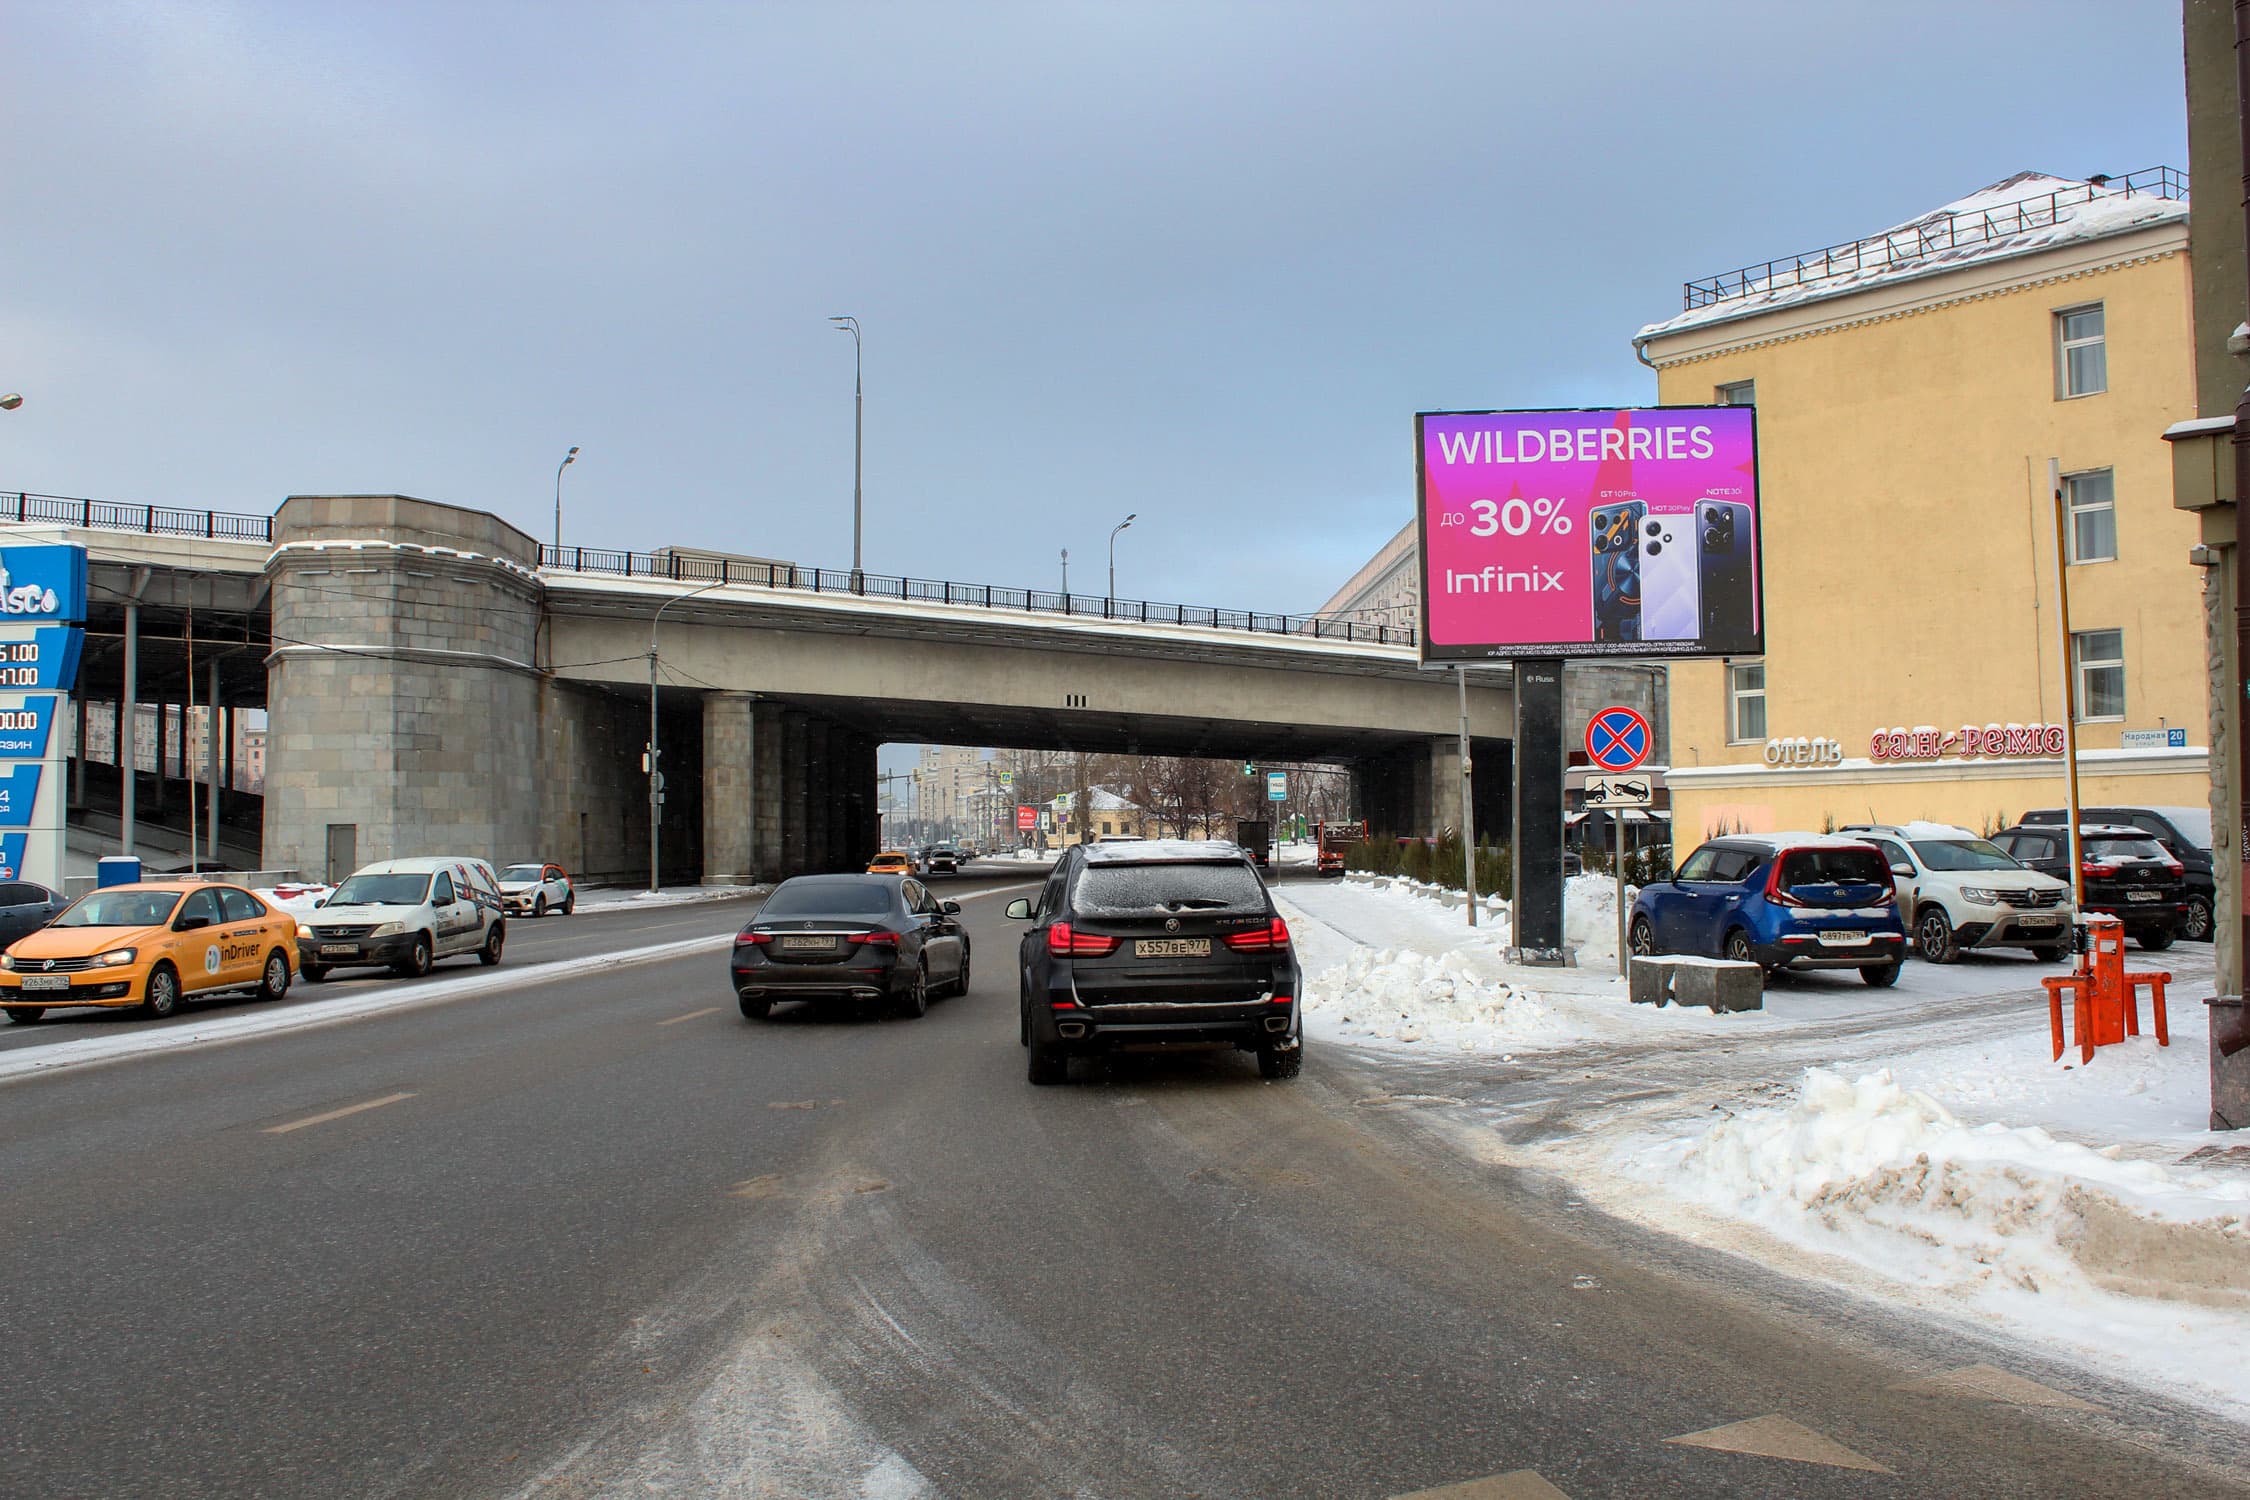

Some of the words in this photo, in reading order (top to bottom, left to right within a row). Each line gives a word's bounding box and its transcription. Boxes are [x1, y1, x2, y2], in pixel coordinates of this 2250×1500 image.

[1438, 426, 1714, 464] WILDBERRIES
[1600, 490, 1612, 498] GT
[1706, 487, 1729, 496] NOTE
[1470, 497, 1572, 536] 30%
[1446, 565, 1564, 594] Infinix
[2125, 732, 2166, 741] Народная
[2170, 730, 2183, 740] 20
[221, 943, 261, 961] inDriver
